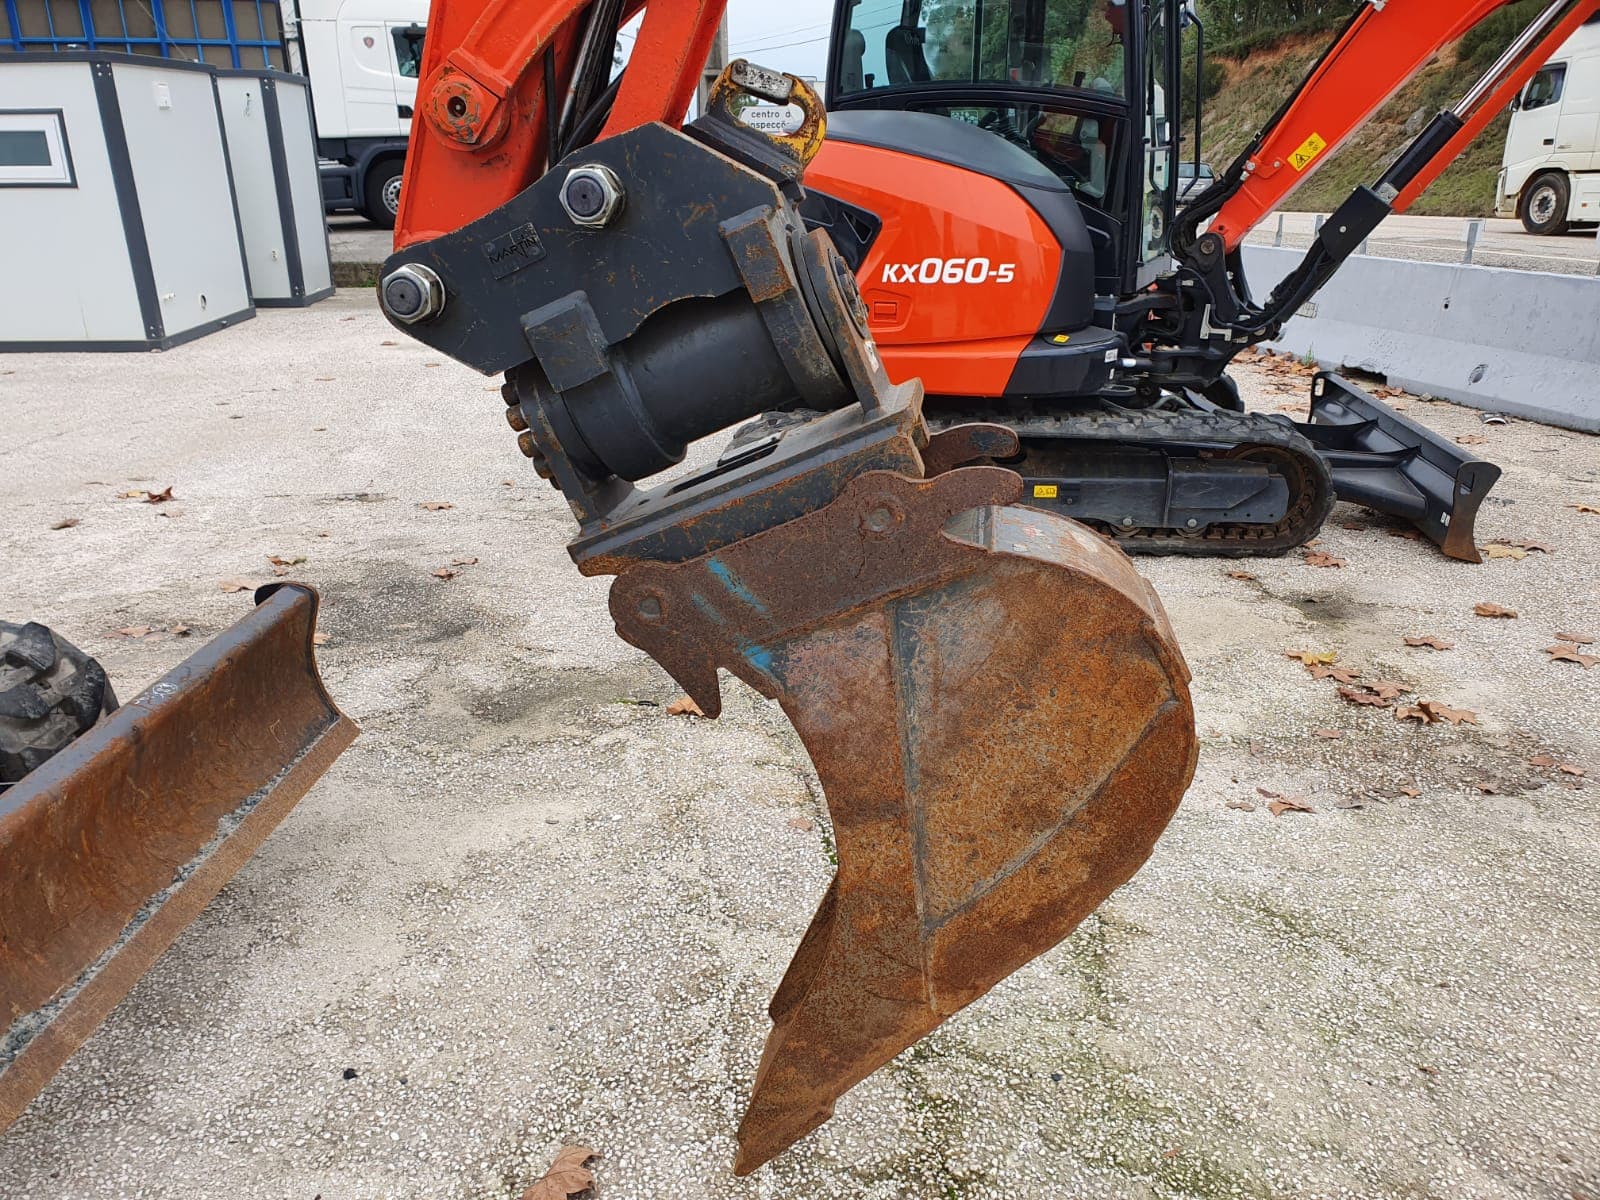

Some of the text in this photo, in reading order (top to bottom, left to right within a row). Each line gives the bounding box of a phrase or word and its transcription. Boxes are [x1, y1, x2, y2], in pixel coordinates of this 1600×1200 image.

[751, 110, 780, 118] centro
[489, 234, 540, 264] MARTIN
[881, 257, 1016, 284] KX060-5
